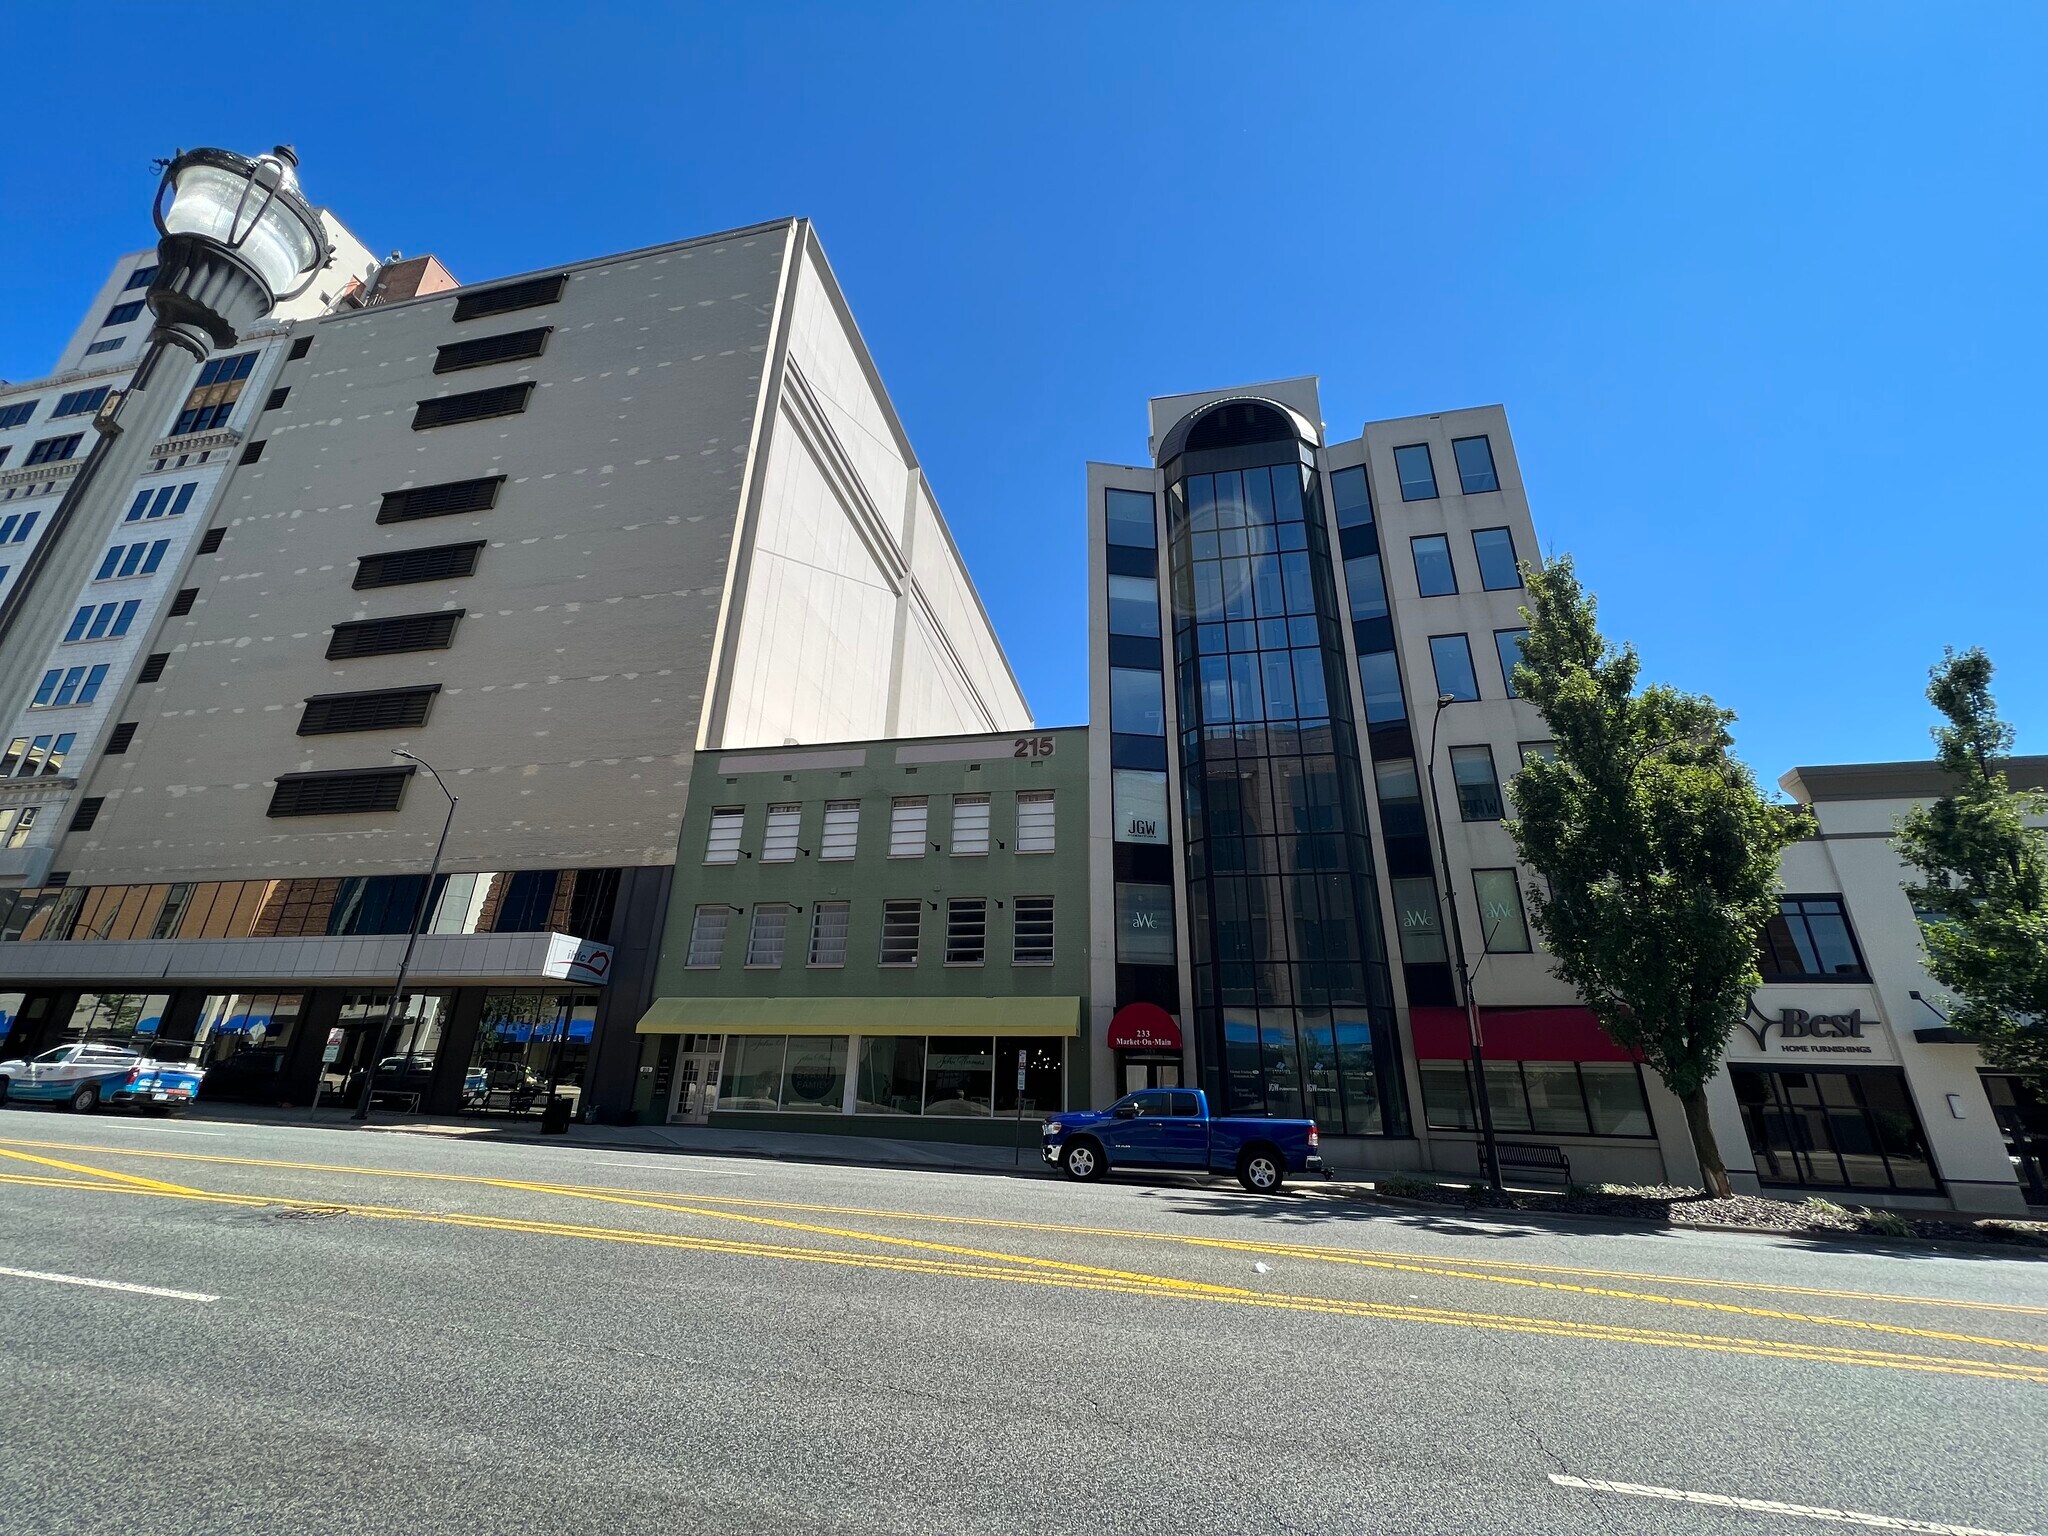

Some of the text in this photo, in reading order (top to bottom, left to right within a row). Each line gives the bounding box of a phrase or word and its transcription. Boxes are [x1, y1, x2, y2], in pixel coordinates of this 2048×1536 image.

[1014, 737, 1054, 757] 215
[1128, 820, 1156, 835] JGW
[1132, 911, 1158, 929] aWc
[1779, 1008, 1864, 1038] Best
[1782, 1045, 1809, 1053] HOME
